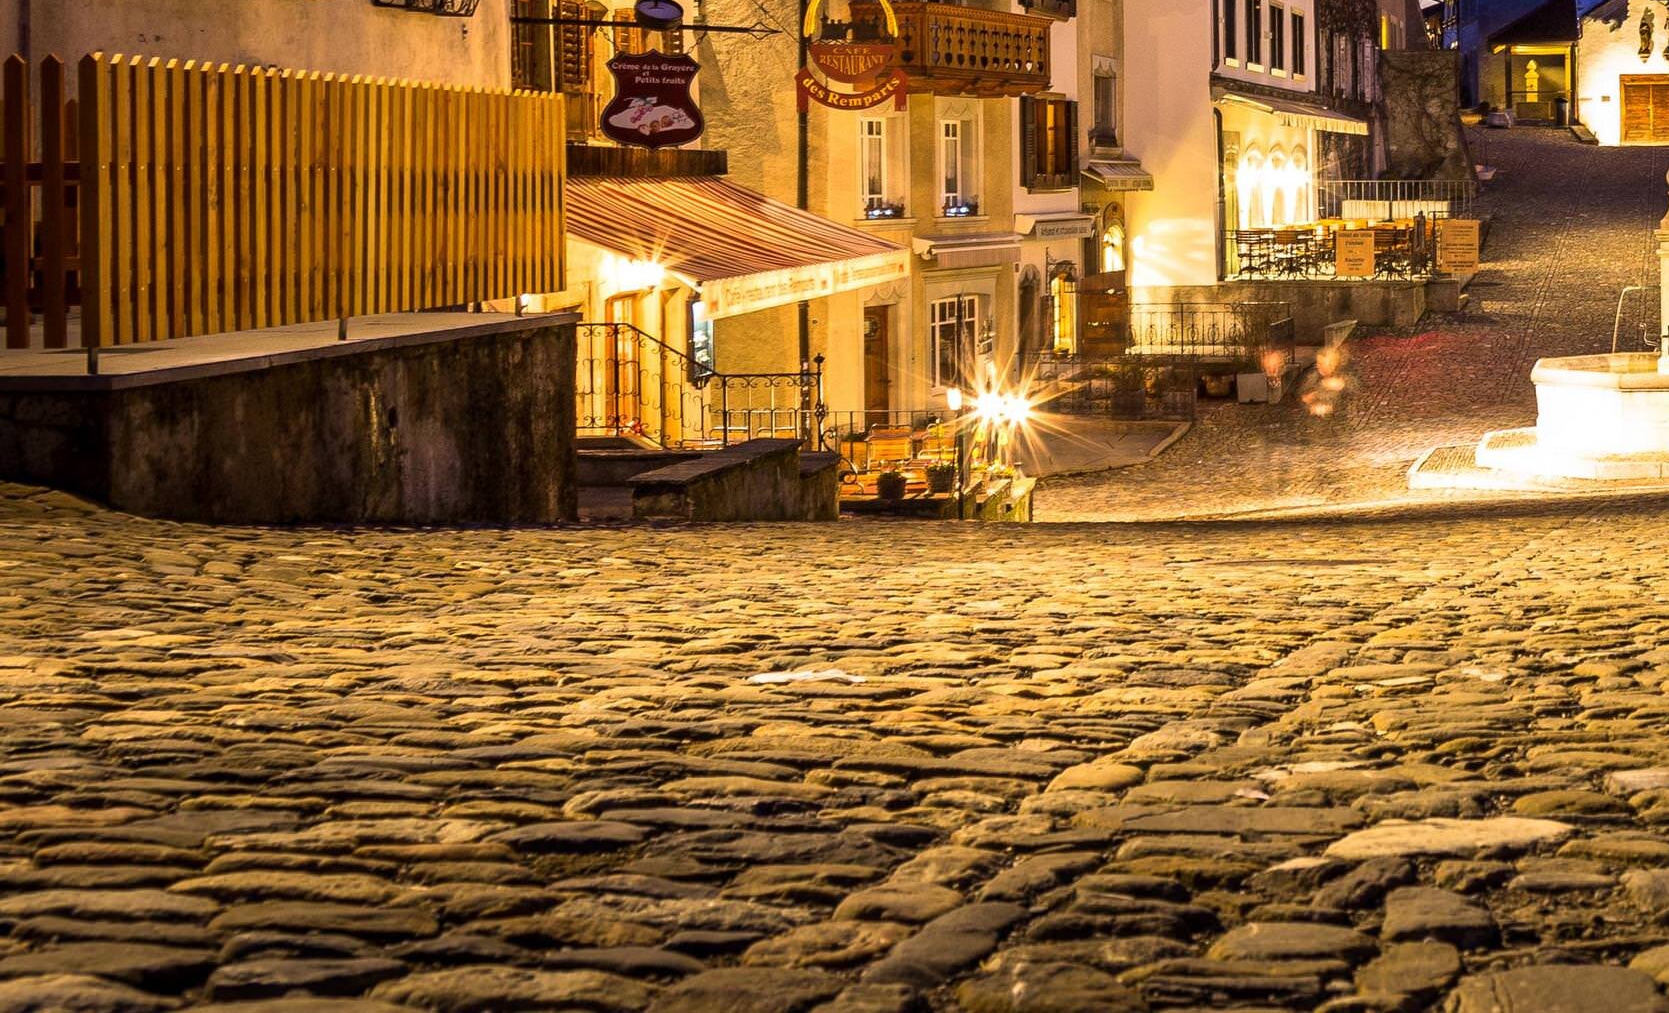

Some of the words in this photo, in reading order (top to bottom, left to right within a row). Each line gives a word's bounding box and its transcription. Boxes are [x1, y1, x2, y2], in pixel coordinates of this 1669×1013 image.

[820, 55, 885, 76] RESTAURANT
[635, 76, 660, 84] Petits
[802, 78, 826, 99] des
[827, 77, 900, 107] Remparts
